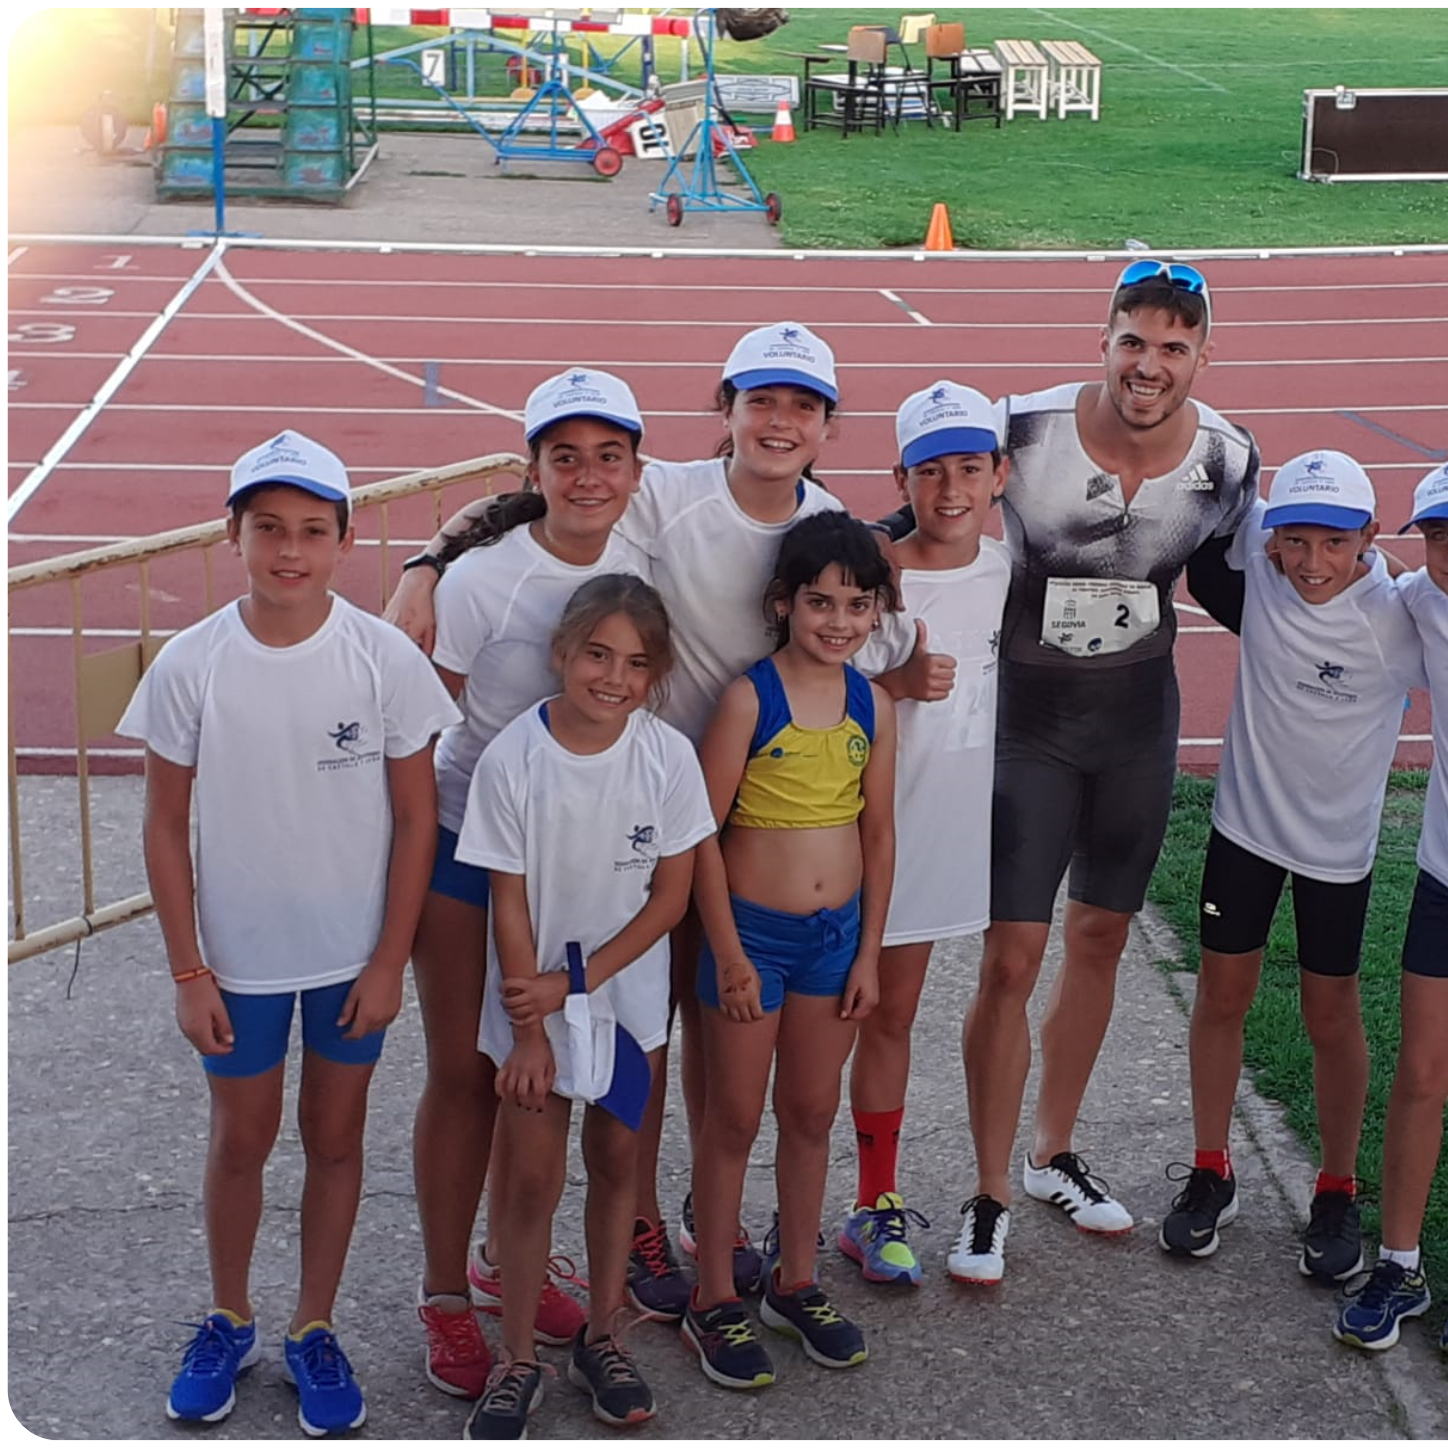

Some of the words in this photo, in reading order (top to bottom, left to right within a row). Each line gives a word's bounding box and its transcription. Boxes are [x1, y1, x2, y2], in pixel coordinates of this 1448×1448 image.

[426, 52, 441, 75] 7
[40, 286, 115, 304] 2
[8, 323, 76, 343] 3
[1176, 480, 1214, 491] adidas
[1289, 484, 1341, 494] VOLUNTARIO
[1051, 620, 1087, 629] SEGOVIA
[1114, 603, 1130, 629] 2
